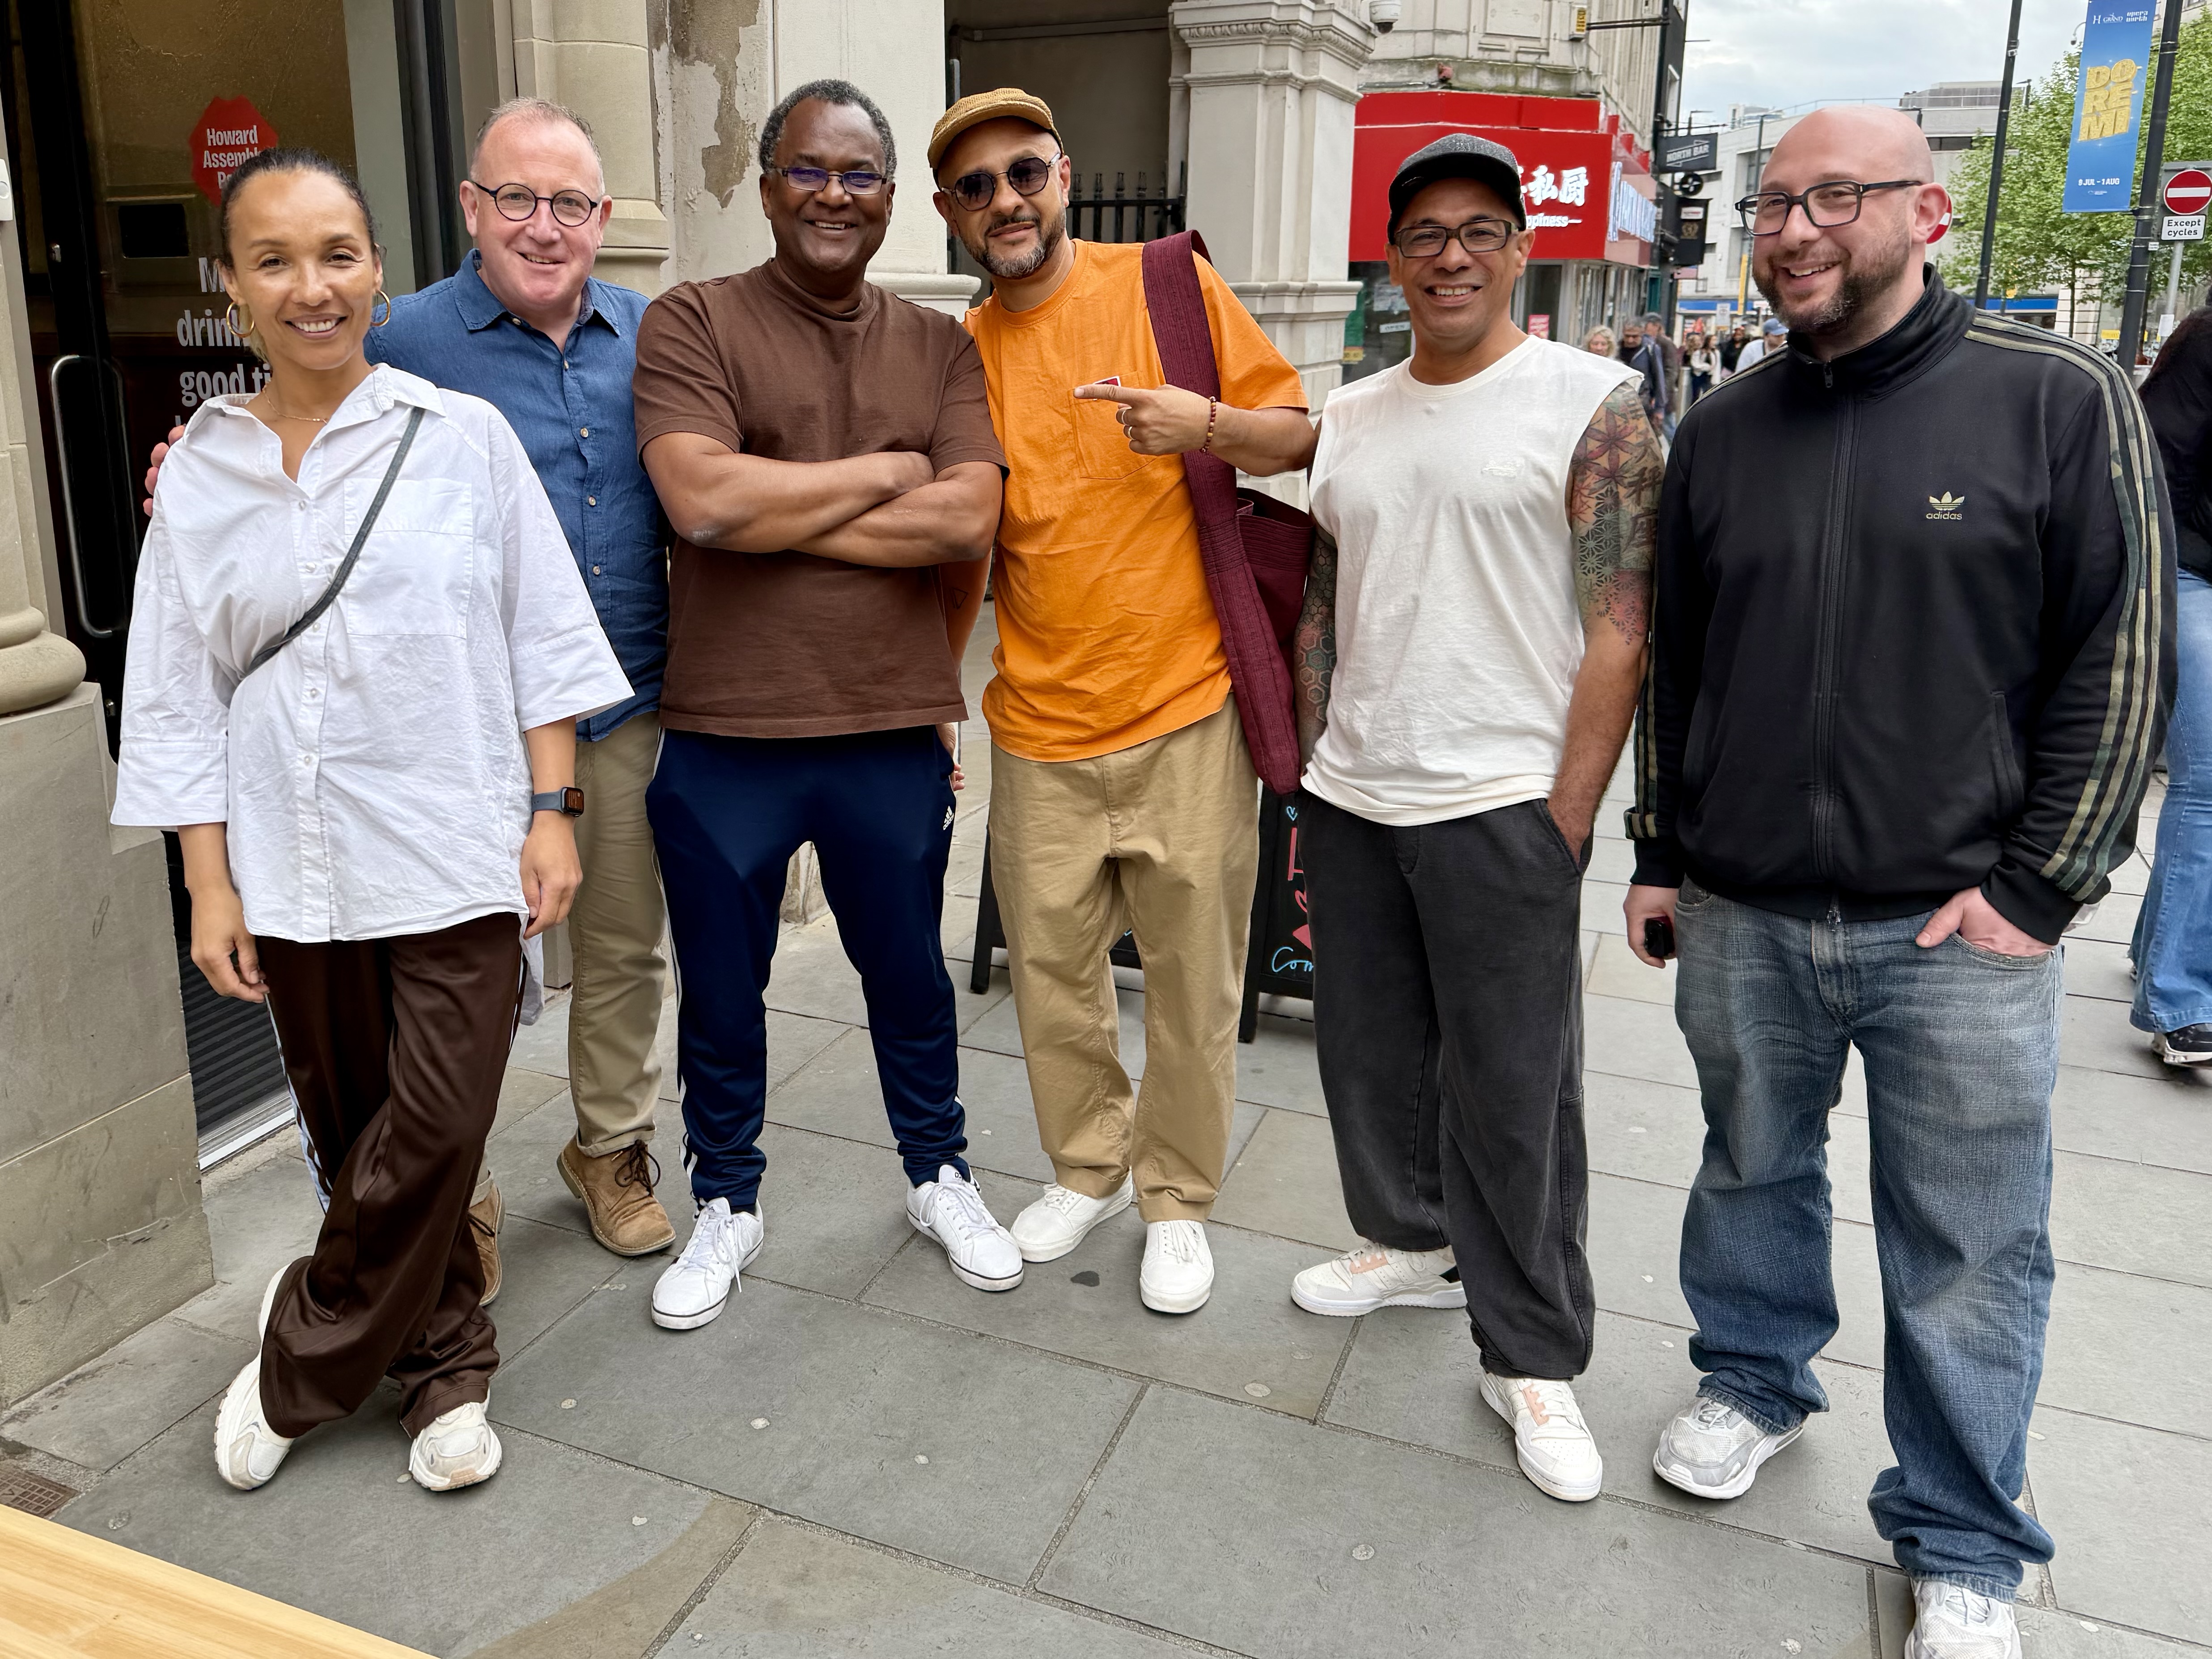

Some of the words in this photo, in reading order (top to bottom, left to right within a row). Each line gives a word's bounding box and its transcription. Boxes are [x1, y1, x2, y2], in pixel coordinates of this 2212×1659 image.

[2085, 59, 2137, 89] DO
[2082, 81, 2133, 115] RE
[207, 125, 258, 146] Howard
[2078, 107, 2131, 141] MI
[203, 147, 261, 168] Assembl
[1518, 165, 1589, 207] 私厨
[2167, 219, 2201, 227] Except
[2168, 229, 2198, 237] cycles
[180, 363, 246, 407] good
[1926, 511, 1962, 520] adidas
